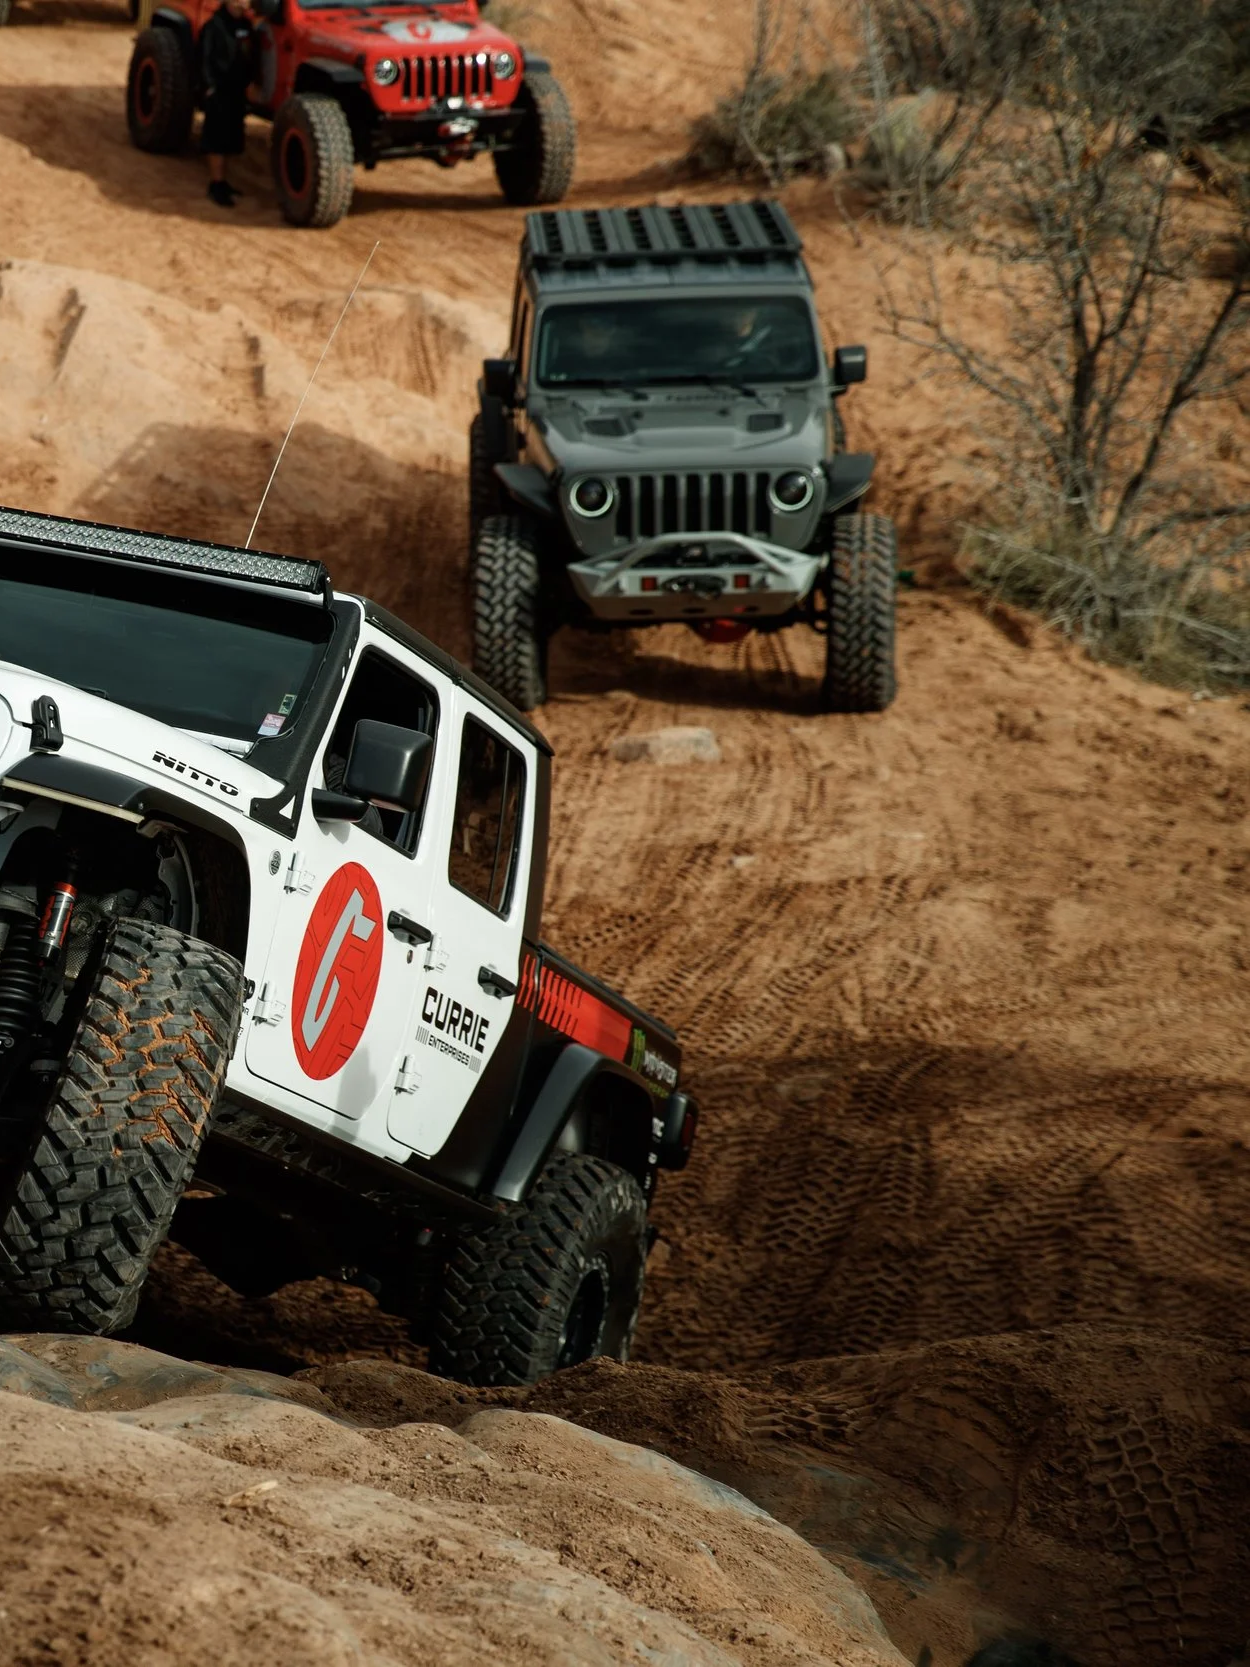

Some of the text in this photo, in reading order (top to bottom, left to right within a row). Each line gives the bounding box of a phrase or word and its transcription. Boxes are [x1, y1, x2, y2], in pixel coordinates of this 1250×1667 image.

[152, 751, 239, 796] NITTO
[422, 986, 490, 1054] CURRIE
[428, 1034, 470, 1066] ENTERPRISES
